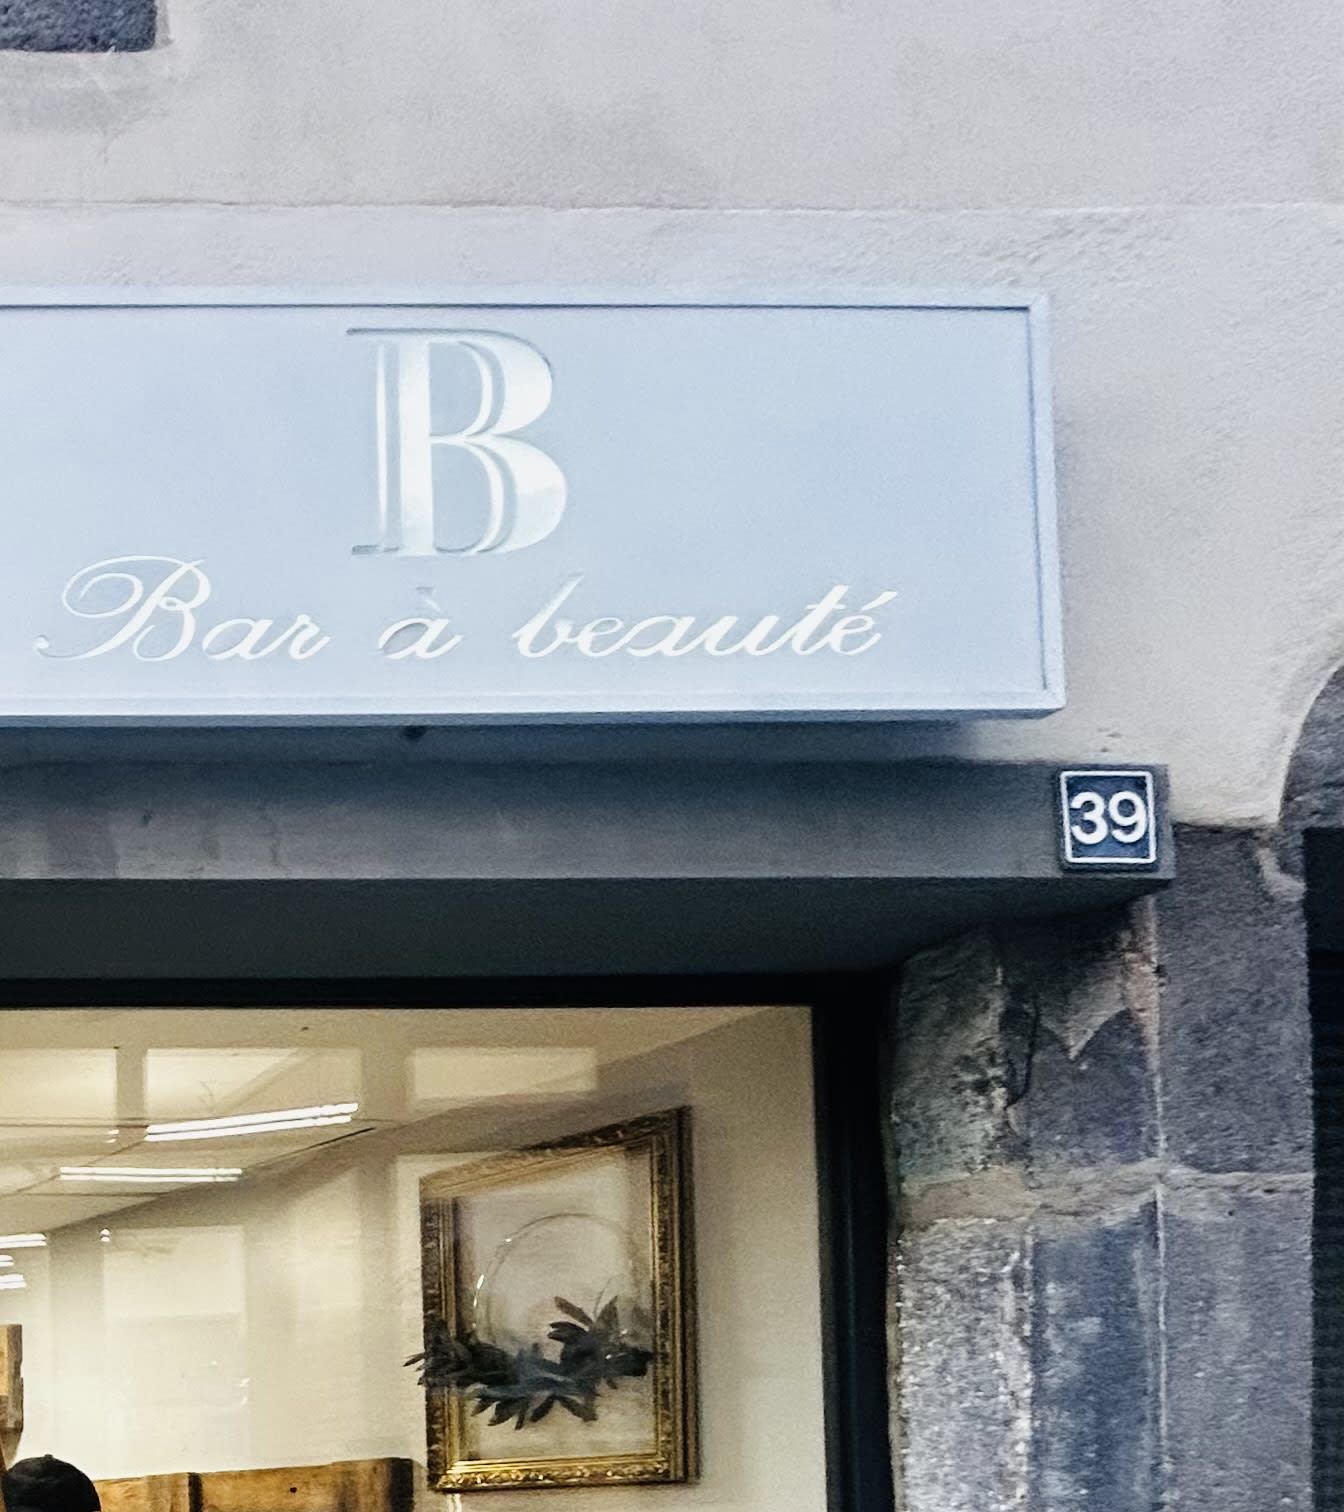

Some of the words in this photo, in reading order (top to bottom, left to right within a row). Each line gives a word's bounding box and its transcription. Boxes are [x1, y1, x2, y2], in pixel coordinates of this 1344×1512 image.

[346, 328, 568, 557] B
[32, 555, 332, 662] Bar
[377, 586, 465, 660] à
[512, 571, 898, 658] beauté
[1070, 790, 1148, 845] 39
